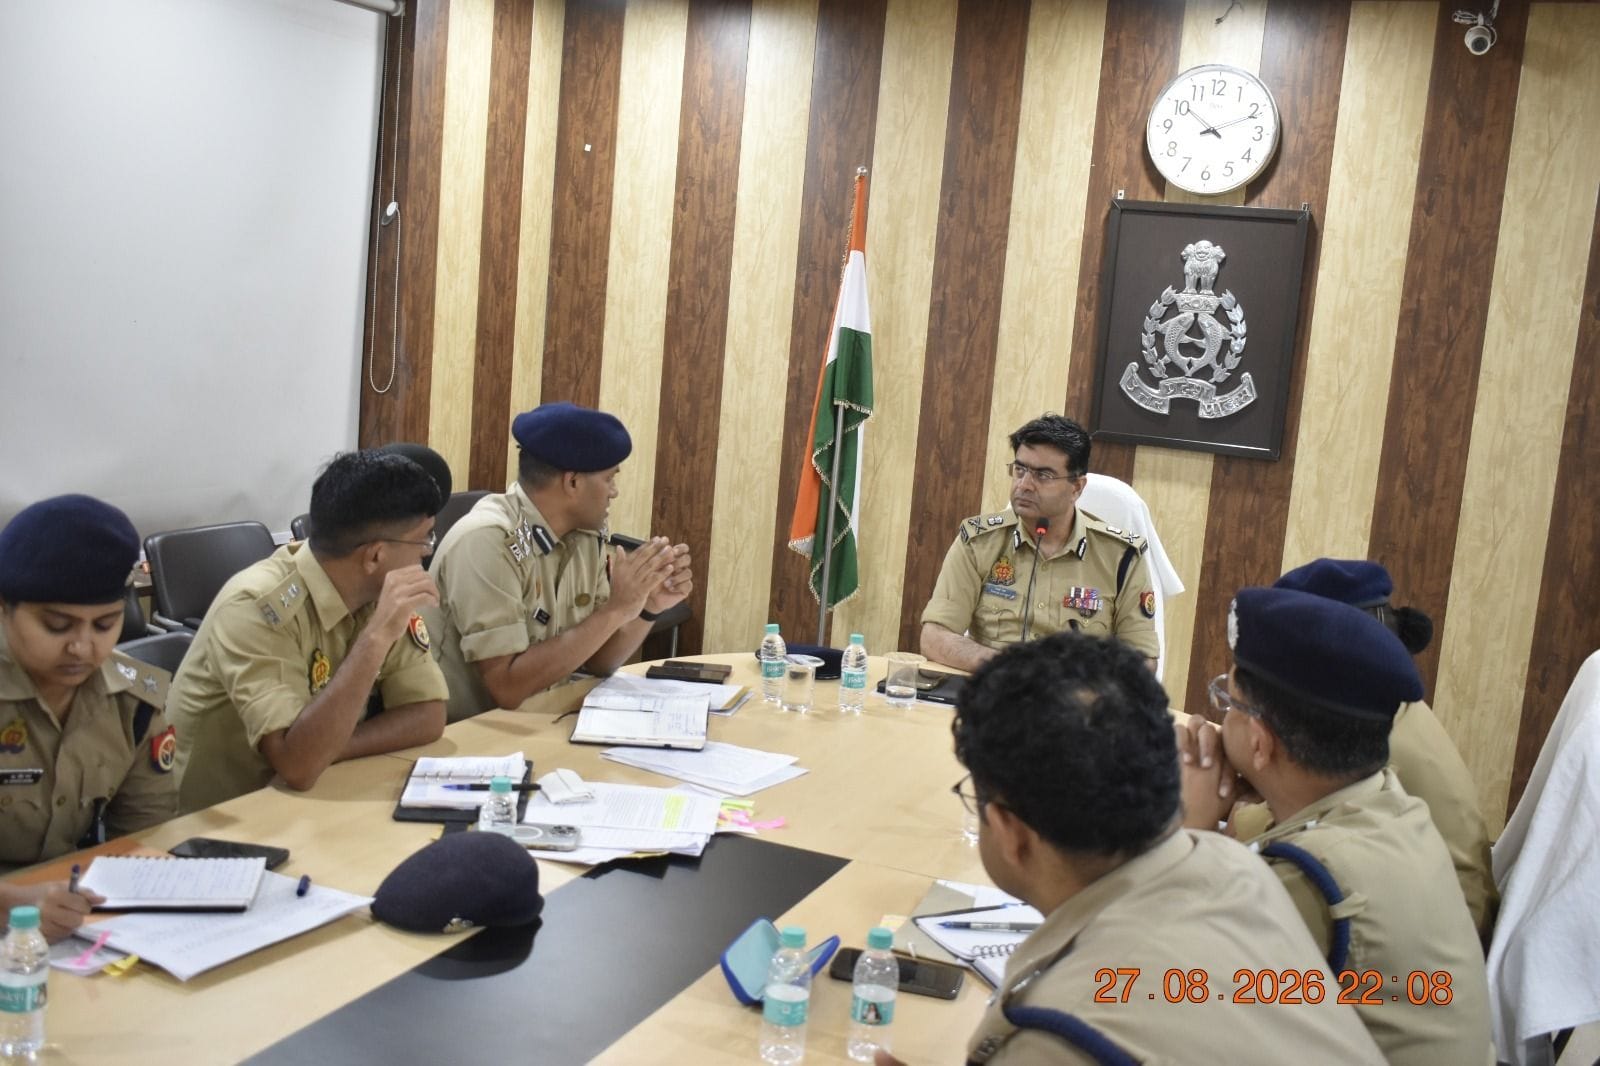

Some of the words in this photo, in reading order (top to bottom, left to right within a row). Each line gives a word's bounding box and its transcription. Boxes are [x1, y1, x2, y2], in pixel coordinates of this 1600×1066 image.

[1191, 85, 1205, 101] 11
[1212, 79, 1226, 96] 12
[1238, 86, 1243, 102] 1
[1174, 99, 1190, 116] 10
[1248, 103, 1260, 119] 2
[1163, 119, 1173, 134] 9
[1252, 125, 1263, 141] 3
[1166, 141, 1177, 157] 8
[1241, 147, 1252, 163] 4
[1181, 156, 1192, 173] 7
[1222, 161, 1234, 177] 5
[1201, 165, 1211, 181] 6
[509, 543, 524, 562] IPS
